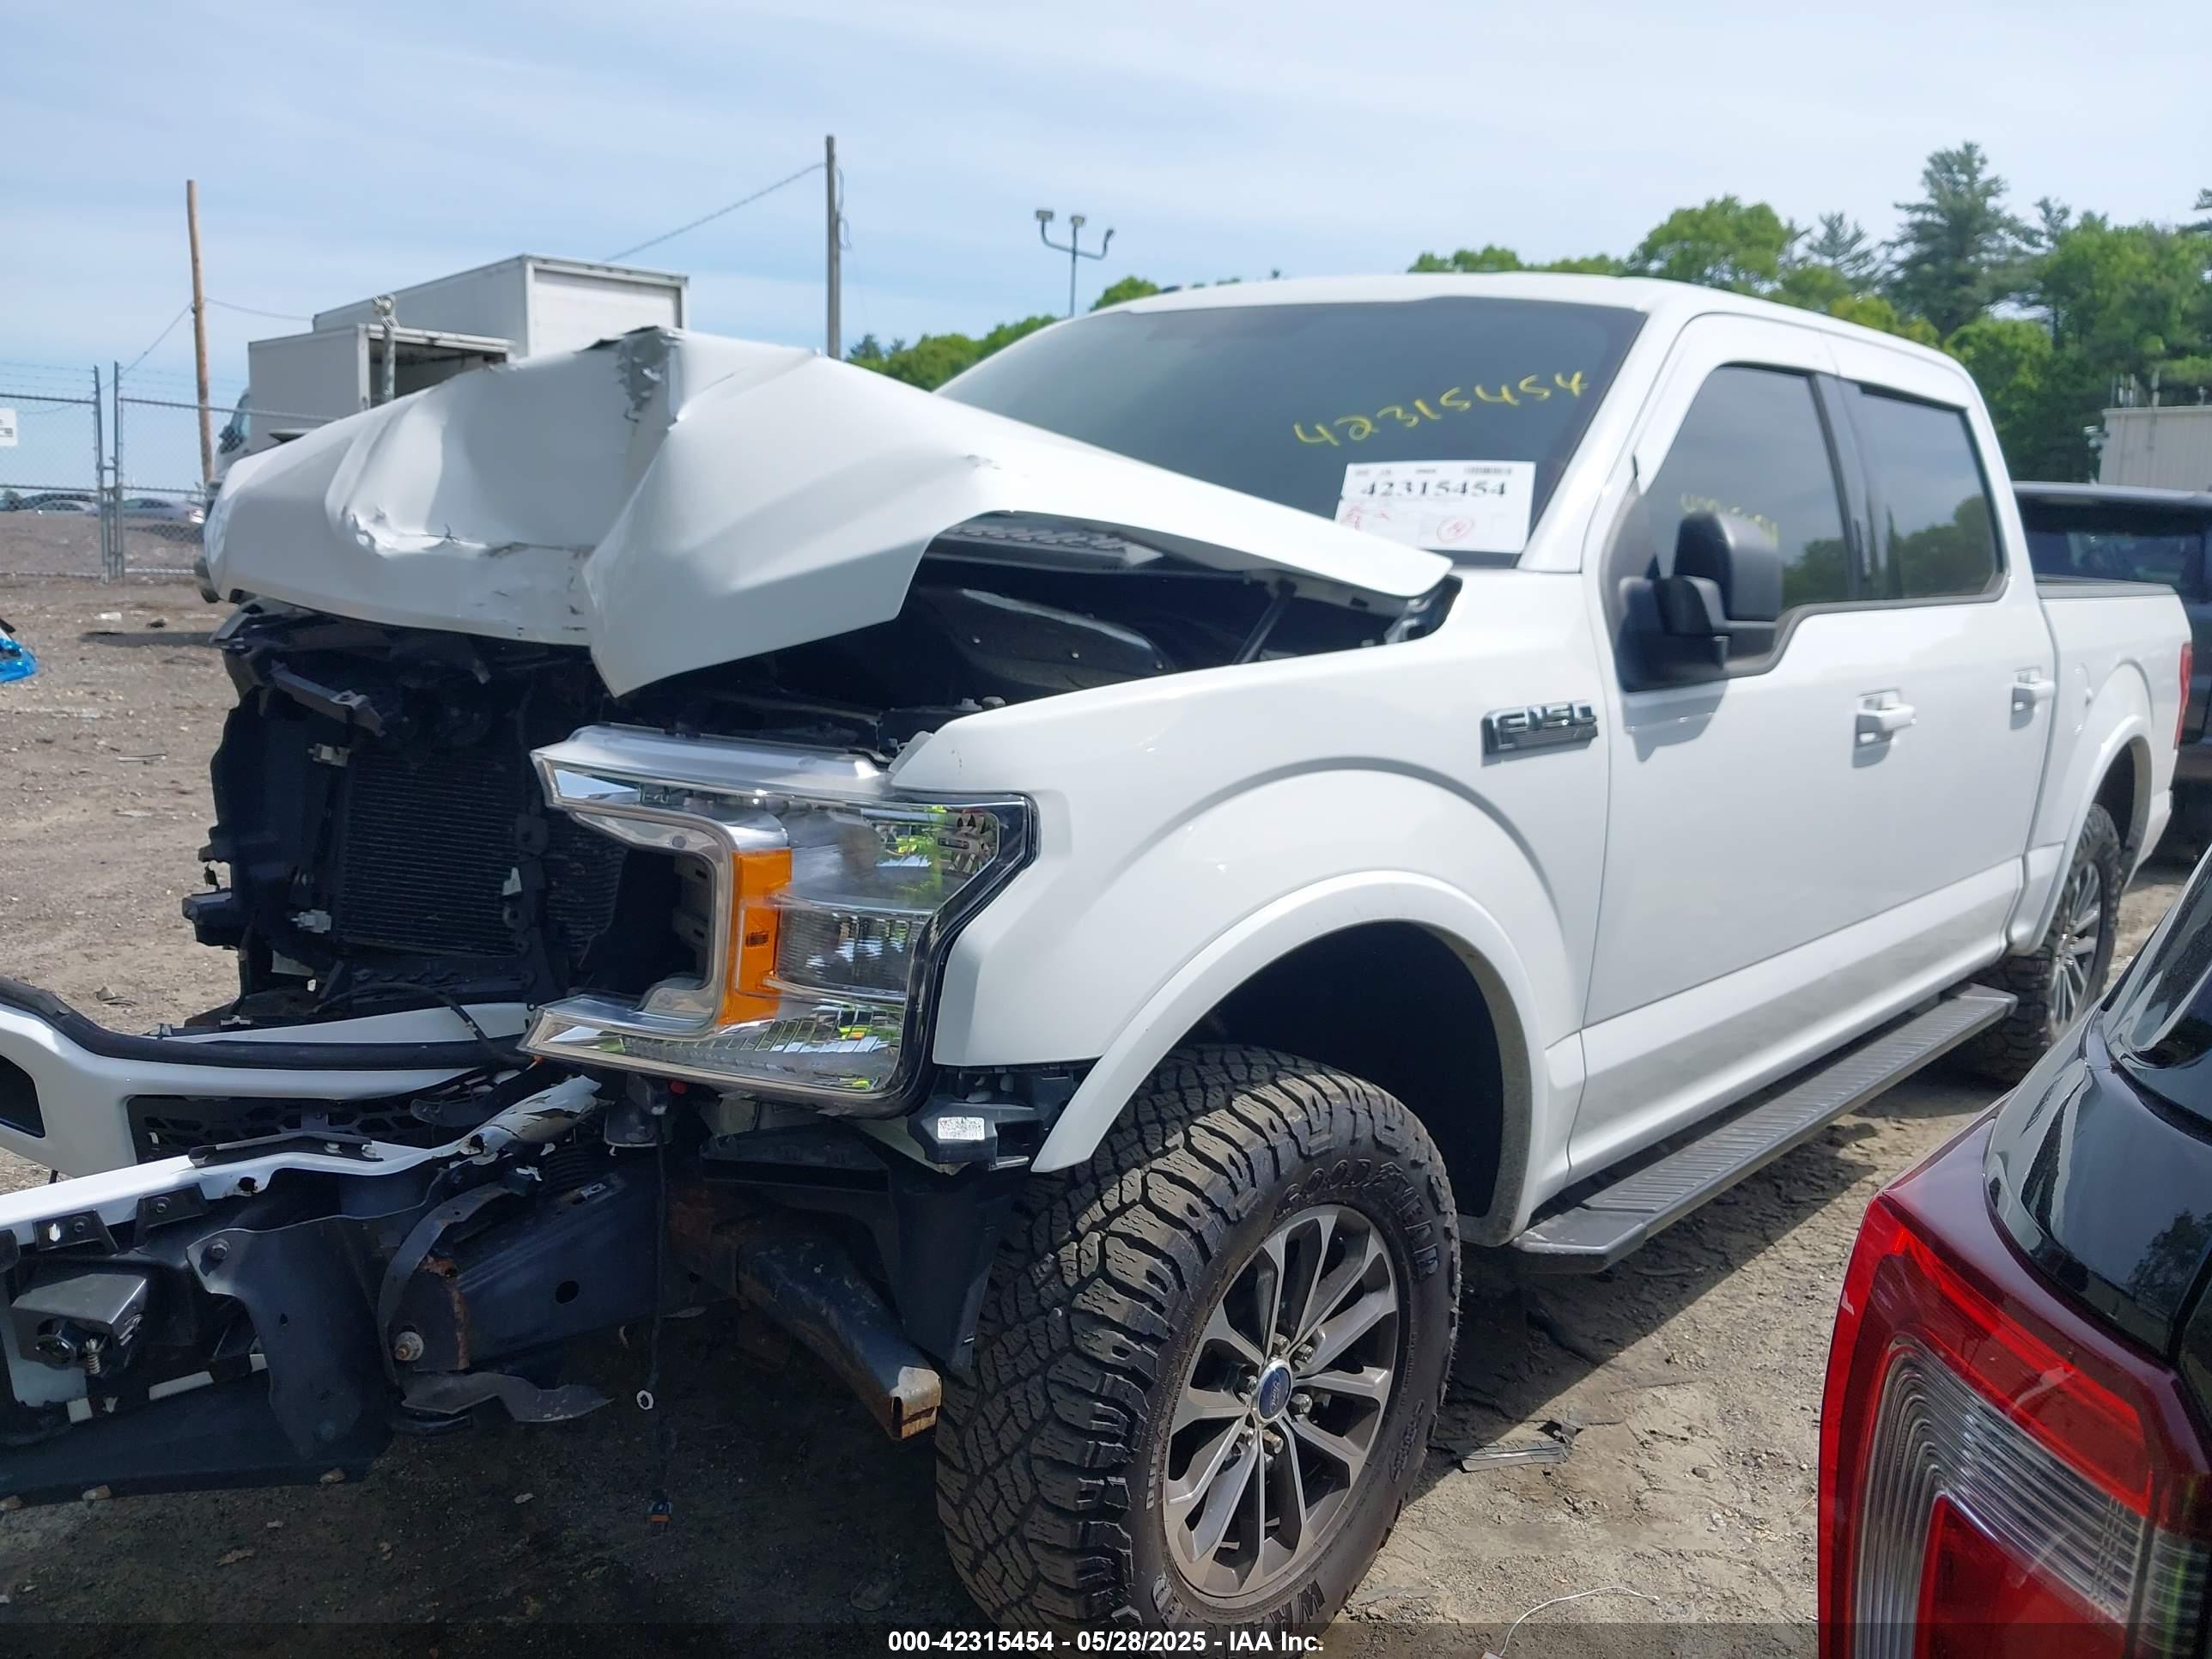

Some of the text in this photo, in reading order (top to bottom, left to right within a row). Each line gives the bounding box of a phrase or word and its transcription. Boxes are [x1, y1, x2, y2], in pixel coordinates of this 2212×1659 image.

[1293, 371, 1589, 446] 42315454
[1361, 480, 1506, 497] 42315454
[1274, 1158, 1439, 1277] GOODYEAR
